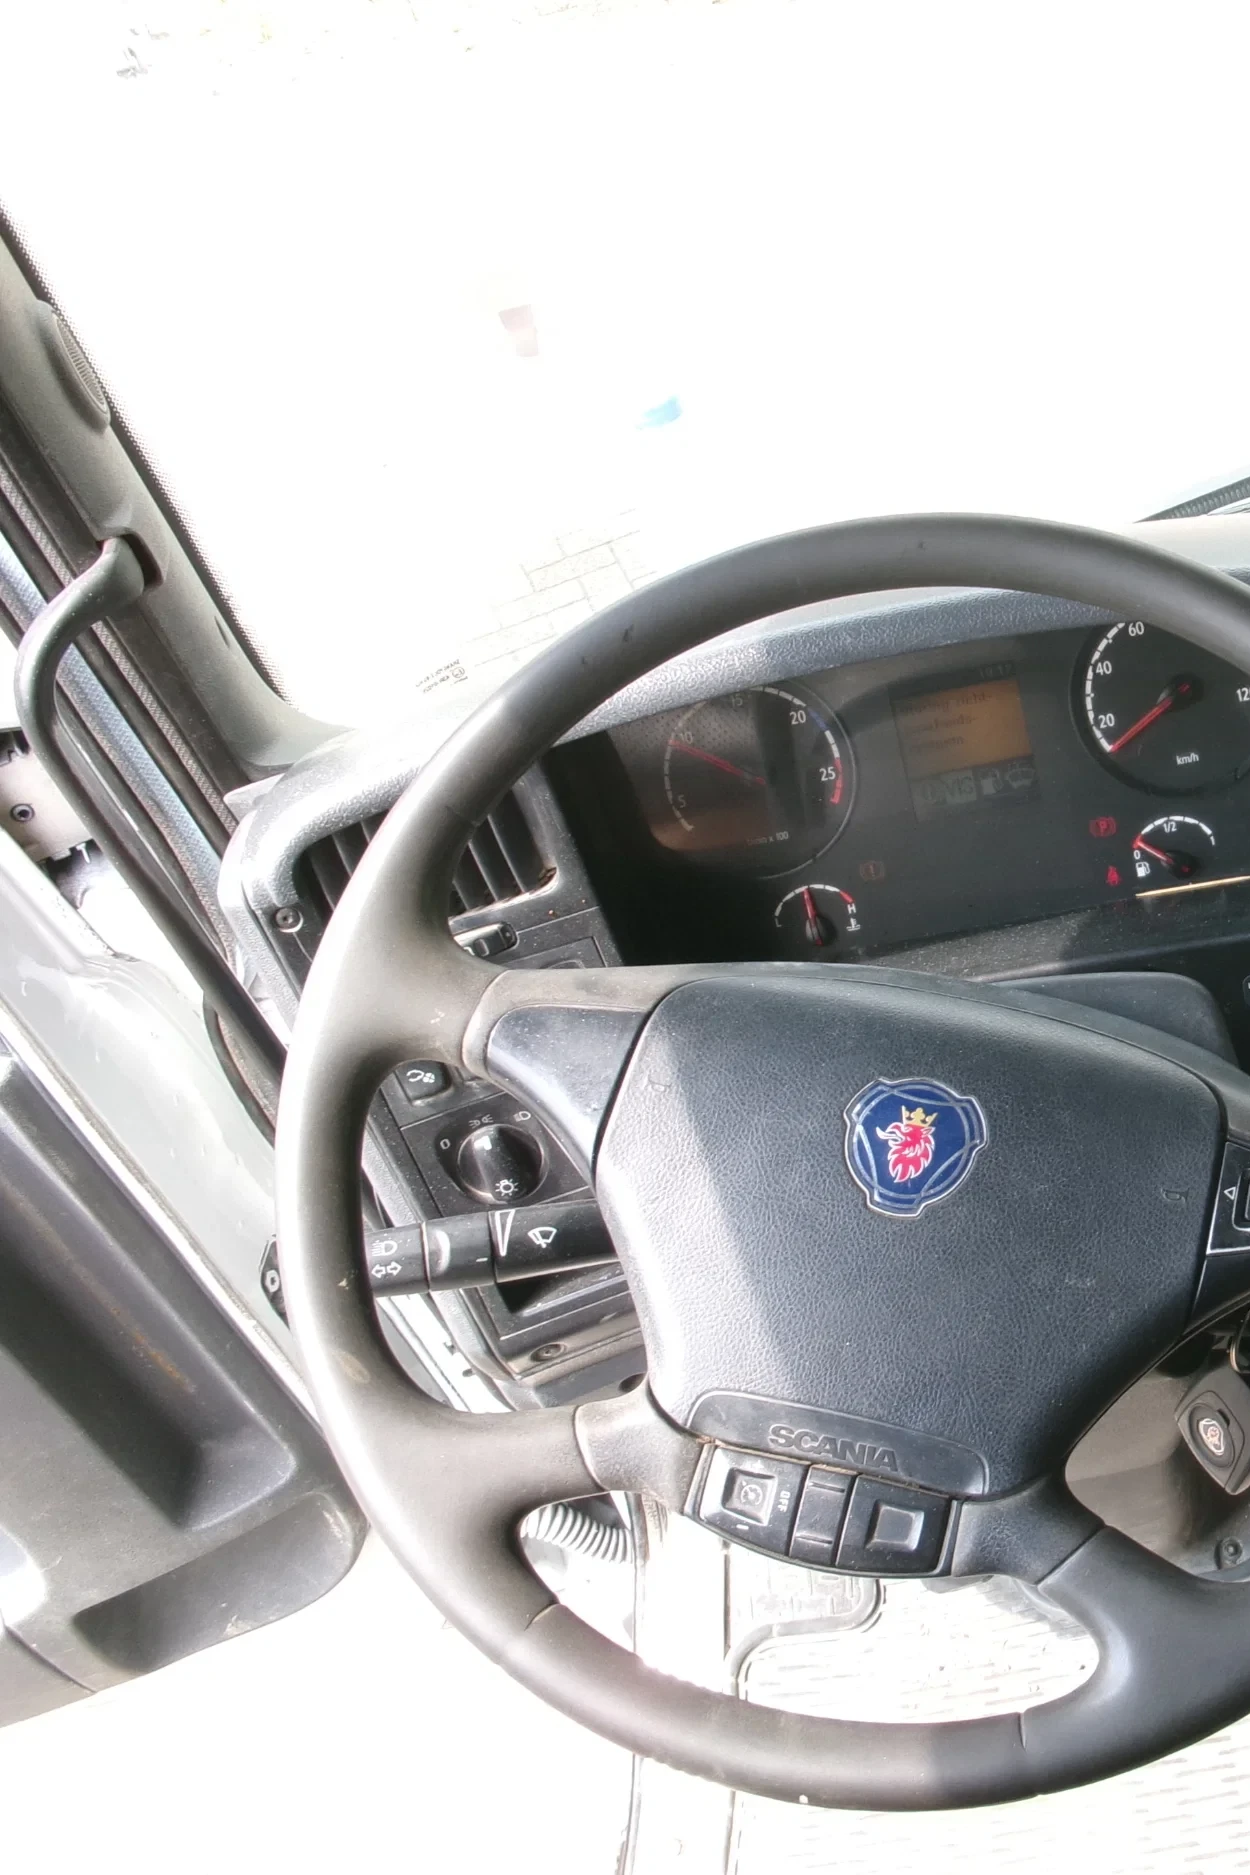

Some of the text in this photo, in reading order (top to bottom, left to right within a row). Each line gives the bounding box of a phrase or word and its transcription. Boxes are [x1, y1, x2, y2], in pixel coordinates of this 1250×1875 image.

[1128, 621, 1145, 637] 60
[1095, 660, 1112, 675] 40
[789, 710, 807, 725] 20
[1098, 713, 1115, 729] 20
[680, 731, 693, 744] 10
[1176, 752, 1199, 765] km/h
[819, 766, 836, 781] 25
[677, 795, 686, 808] 5
[1163, 821, 1177, 833] 1/2
[776, 831, 789, 841] 100
[847, 903, 857, 914] H
[767, 1423, 899, 1473] SCANIA
[778, 1490, 791, 1513] OFF
